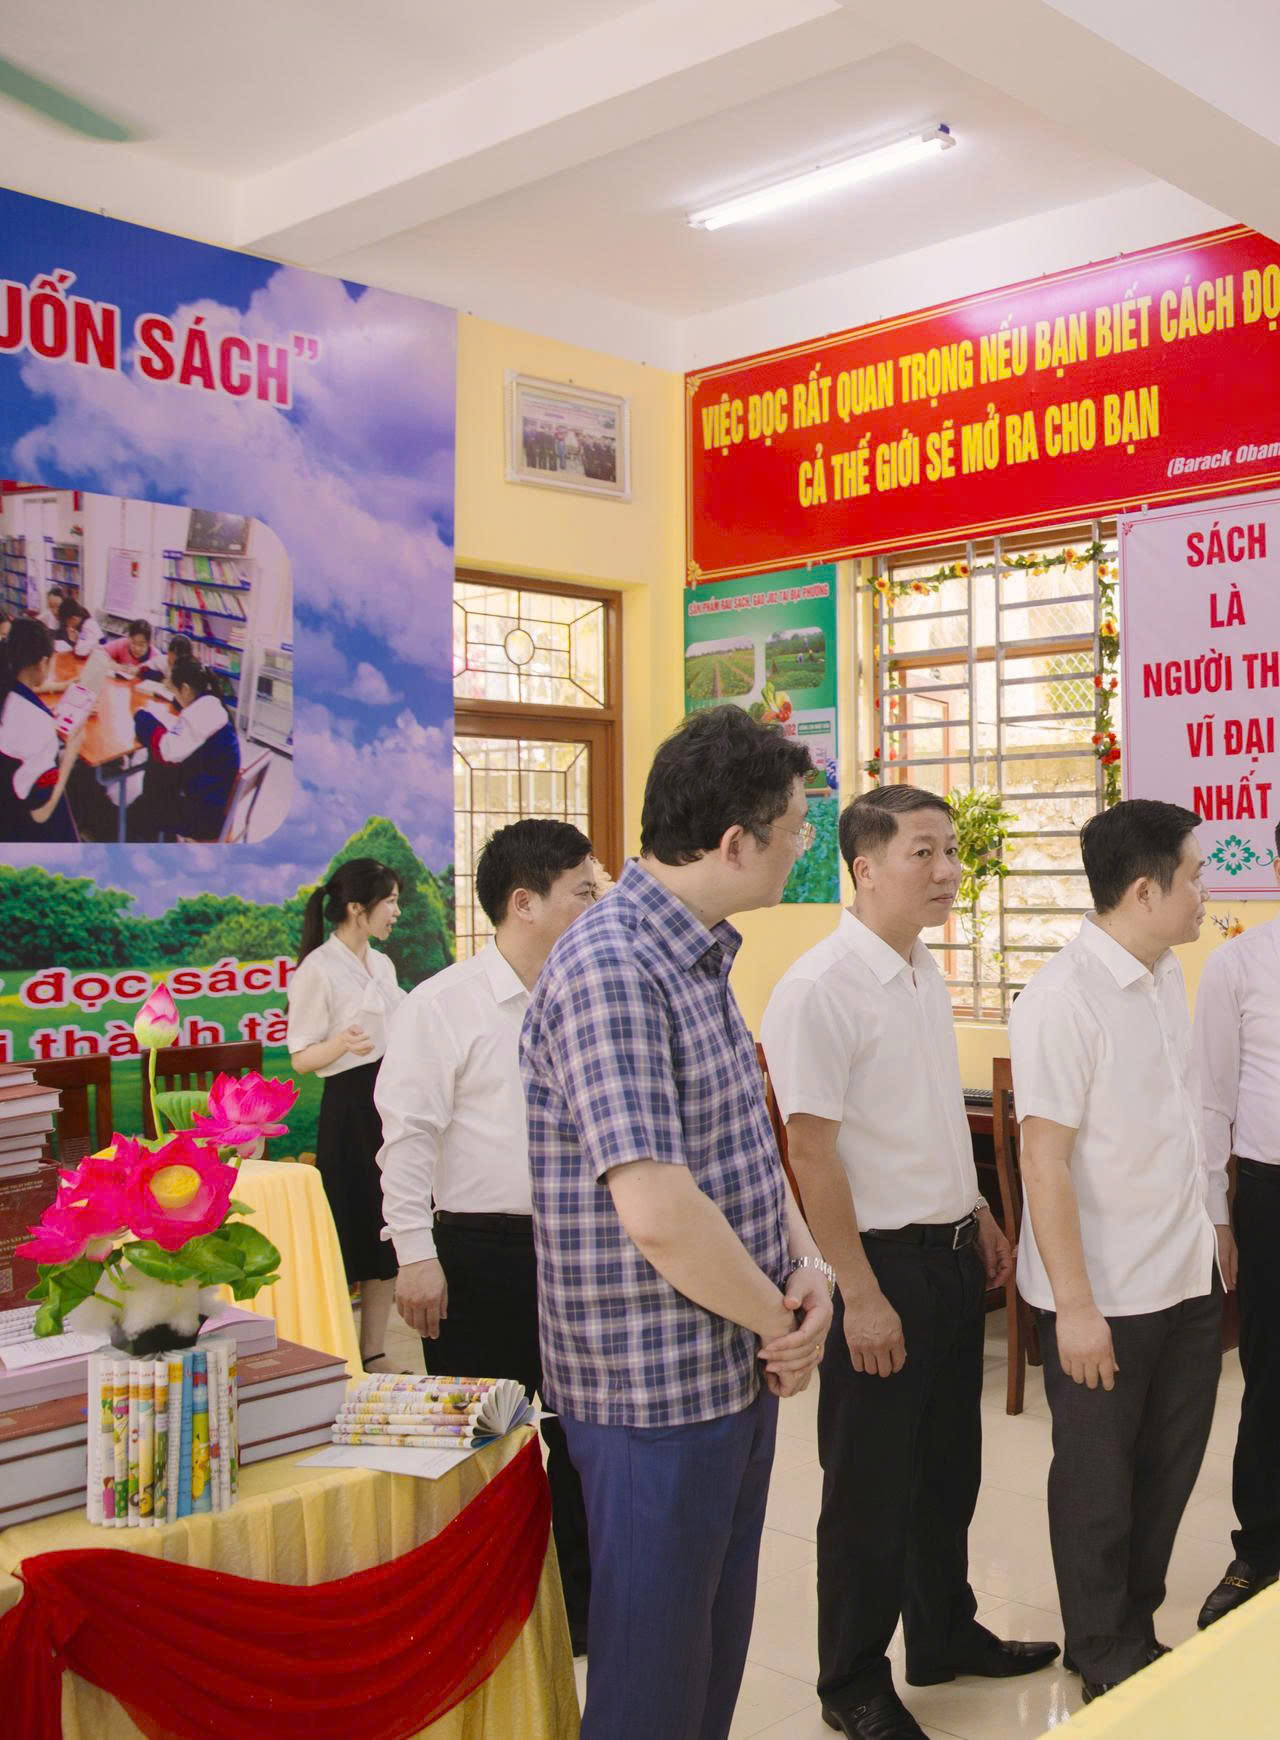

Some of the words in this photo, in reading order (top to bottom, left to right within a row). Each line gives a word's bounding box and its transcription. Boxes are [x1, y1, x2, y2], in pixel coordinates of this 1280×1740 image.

[702, 391, 744, 455] VIỆC
[747, 388, 788, 441] ĐỌC
[793, 359, 830, 430] RẤT
[836, 360, 894, 421] QUAN
[899, 339, 975, 410] TRỌNG
[980, 312, 1029, 386] NẾU
[1034, 310, 1089, 377] BẠN
[1095, 280, 1153, 358] BIẾT
[1159, 276, 1234, 342] CÁCH
[798, 450, 829, 508] CẢ
[830, 426, 871, 501] THẾ
[875, 424, 920, 493] GIỚI
[926, 415, 956, 482] SẼ
[961, 403, 1000, 474] MỞ
[1006, 407, 1039, 465] RA
[1044, 399, 1098, 459] CHO
[1103, 385, 1160, 458] BẠN
[1167, 449, 1232, 478] (Barack
[1185, 520, 1267, 569] SÁCH
[1209, 582, 1247, 630] LÀ
[1142, 648, 1234, 699] NGƯỜI
[1186, 712, 1214, 760] VĨ
[1223, 714, 1276, 764] ĐẠI
[1193, 769, 1273, 822] NHẤT
[26, 972, 147, 1008] đọc
[36, 1021, 220, 1060] thàh
